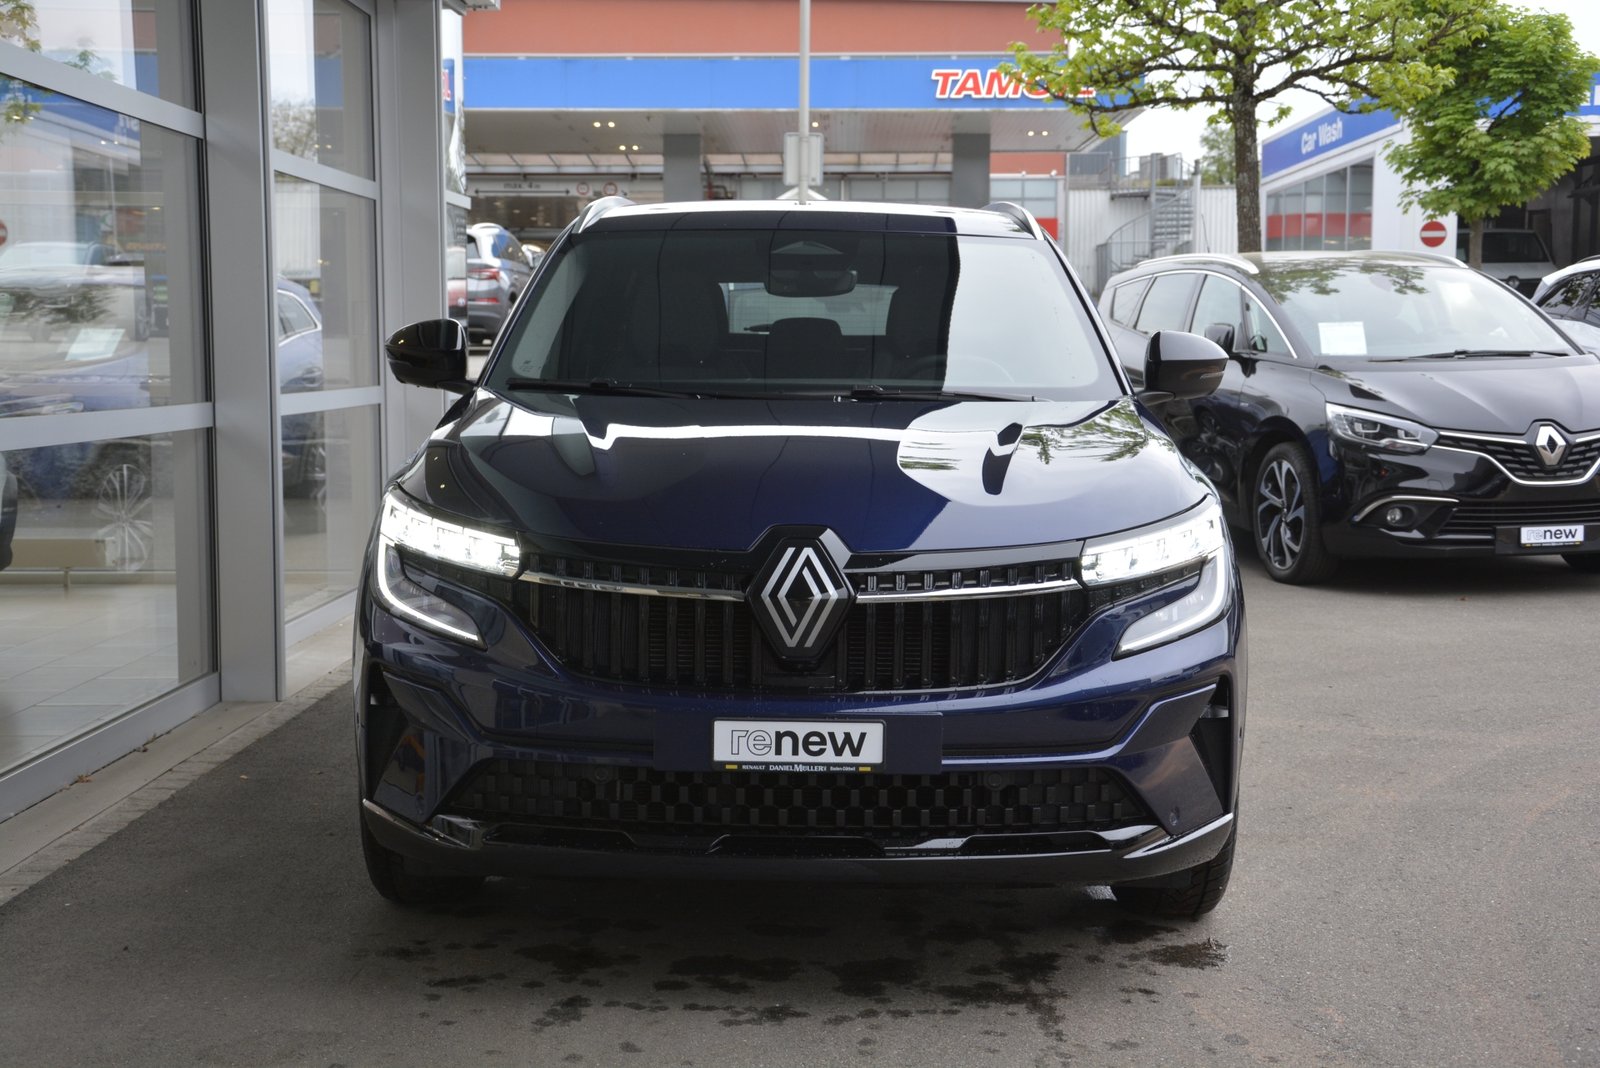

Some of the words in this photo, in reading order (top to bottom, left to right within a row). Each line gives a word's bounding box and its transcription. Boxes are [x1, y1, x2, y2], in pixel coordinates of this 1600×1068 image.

[1302, 132, 1317, 155] Car
[1318, 117, 1343, 147] Wash
[1527, 529, 1577, 541] renew
[731, 730, 867, 757] renew
